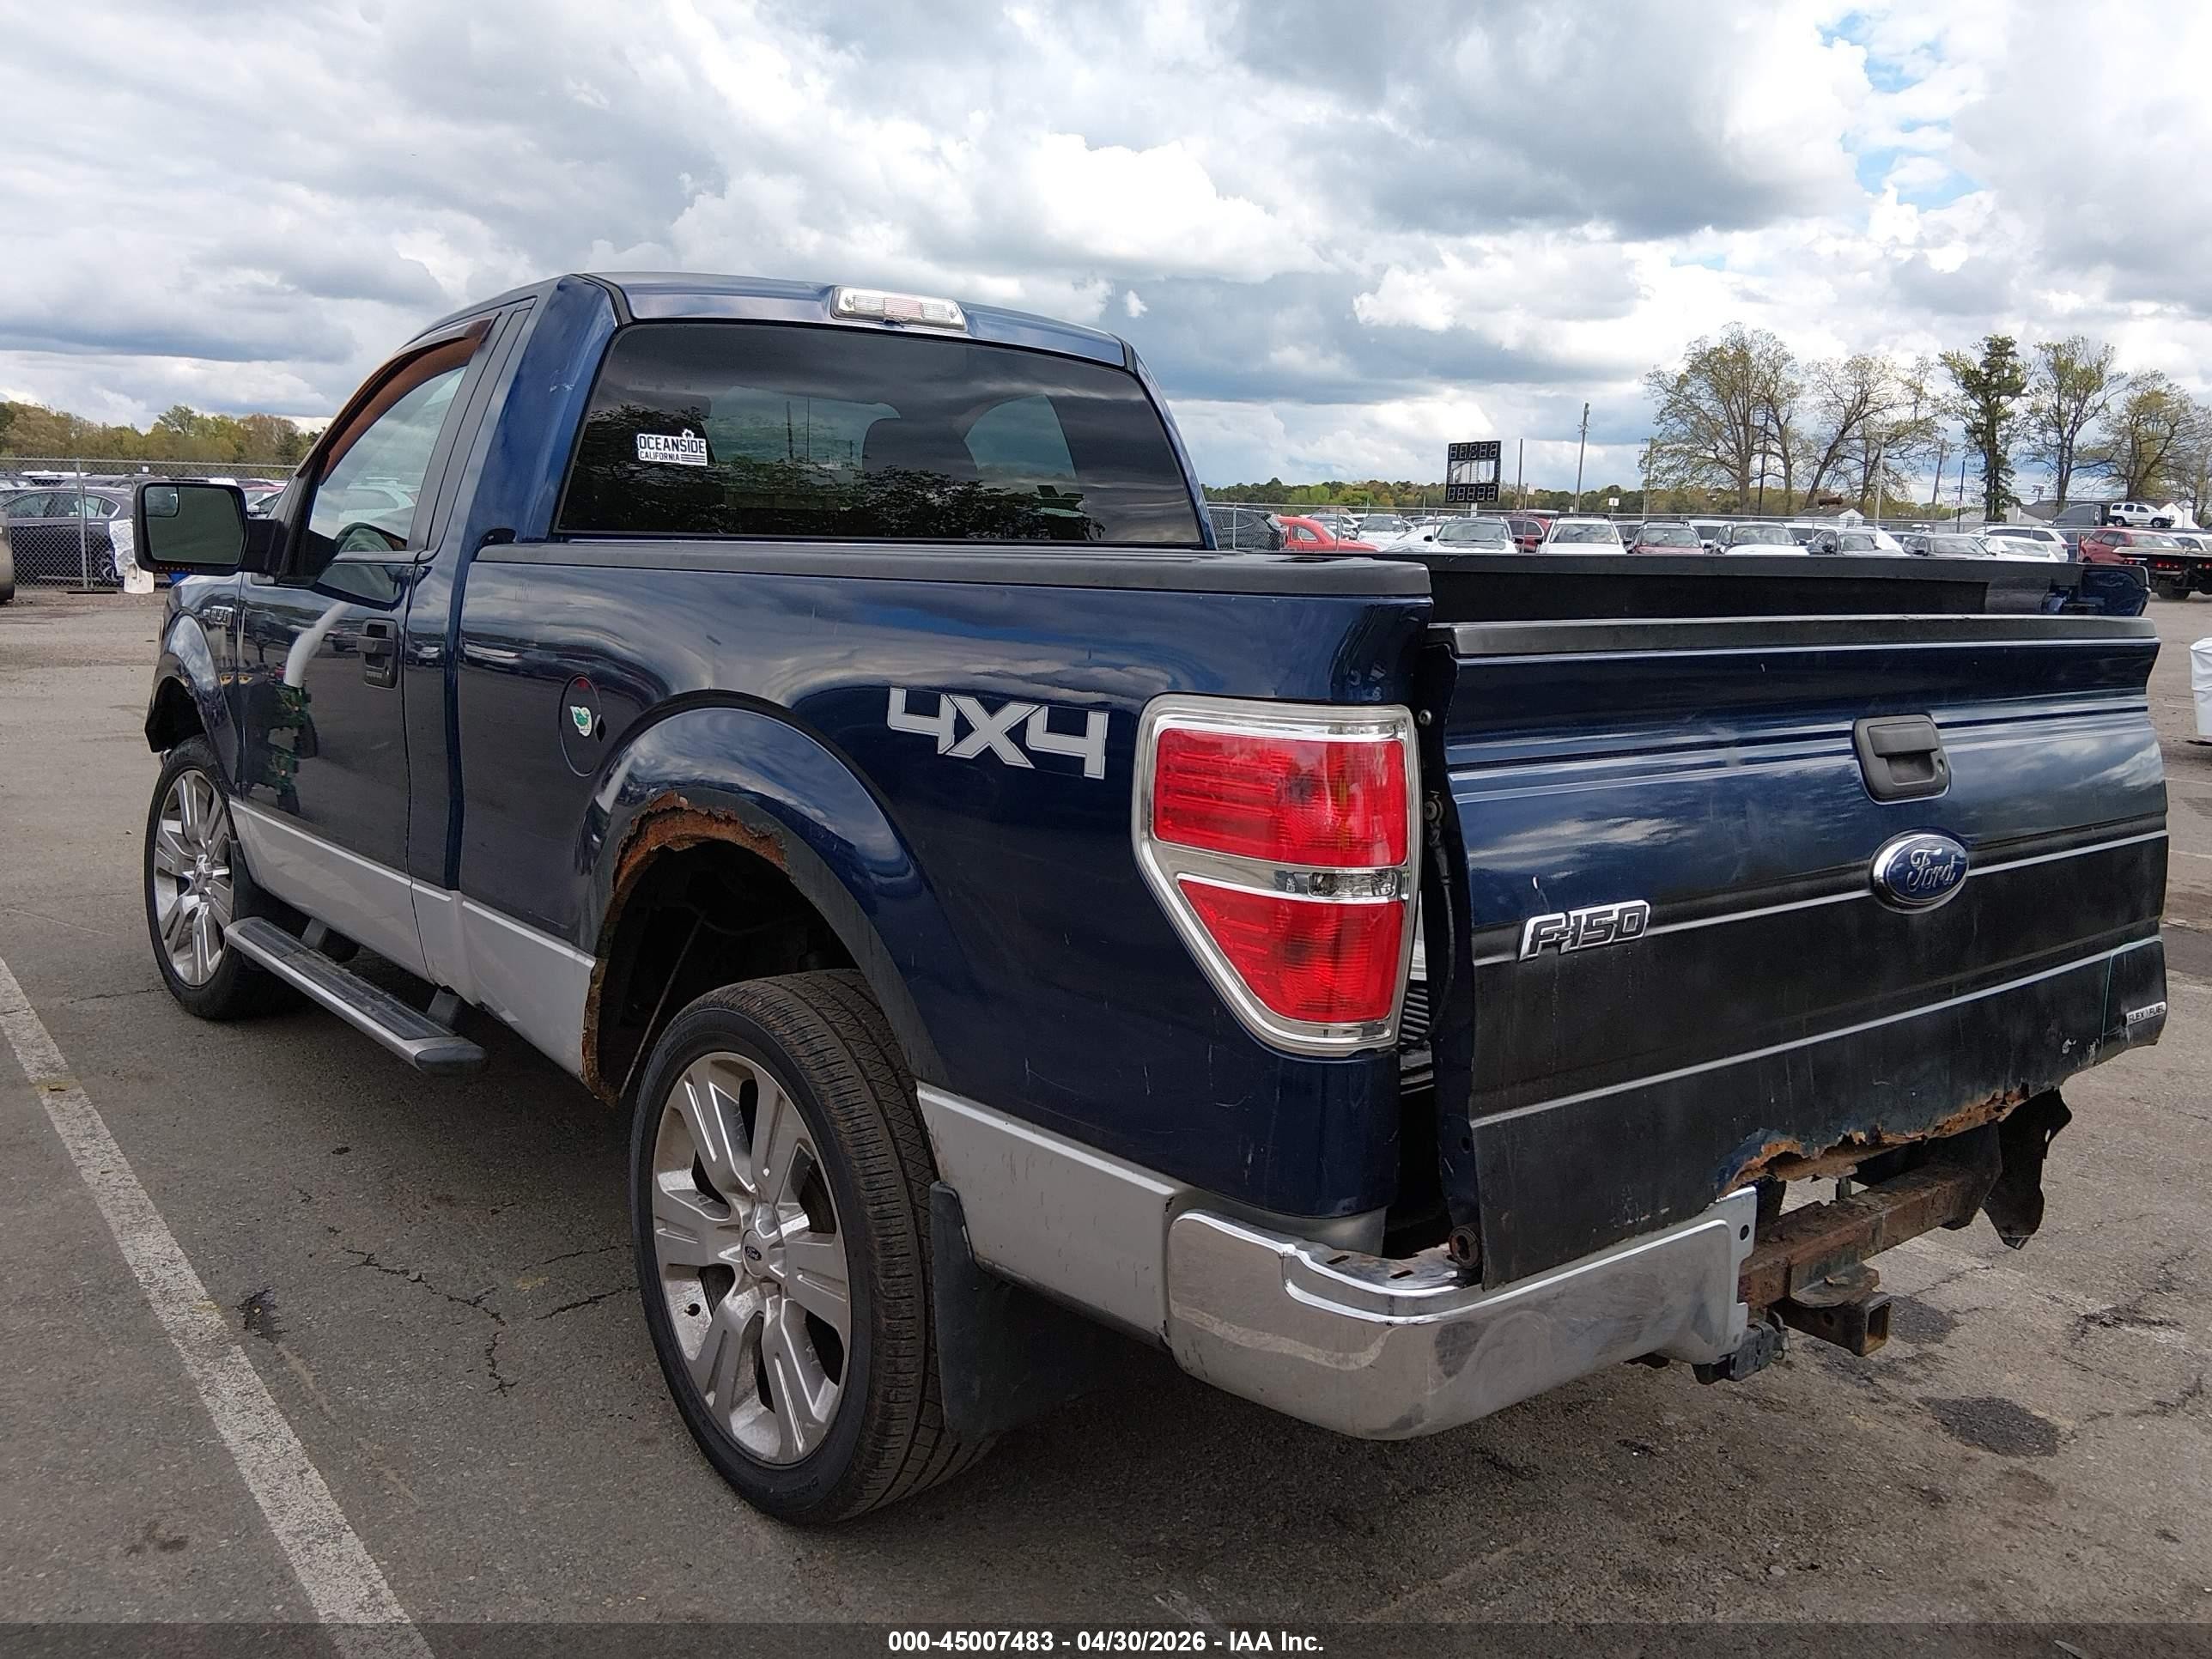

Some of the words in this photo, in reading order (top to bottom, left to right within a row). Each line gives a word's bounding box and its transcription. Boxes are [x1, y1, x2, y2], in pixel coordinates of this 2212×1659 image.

[639, 435, 705, 453] OCEANSIDE
[640, 450, 680, 461] CALIFORNIA
[1907, 848, 1956, 892] Ford
[1519, 899, 1650, 962] F-150
